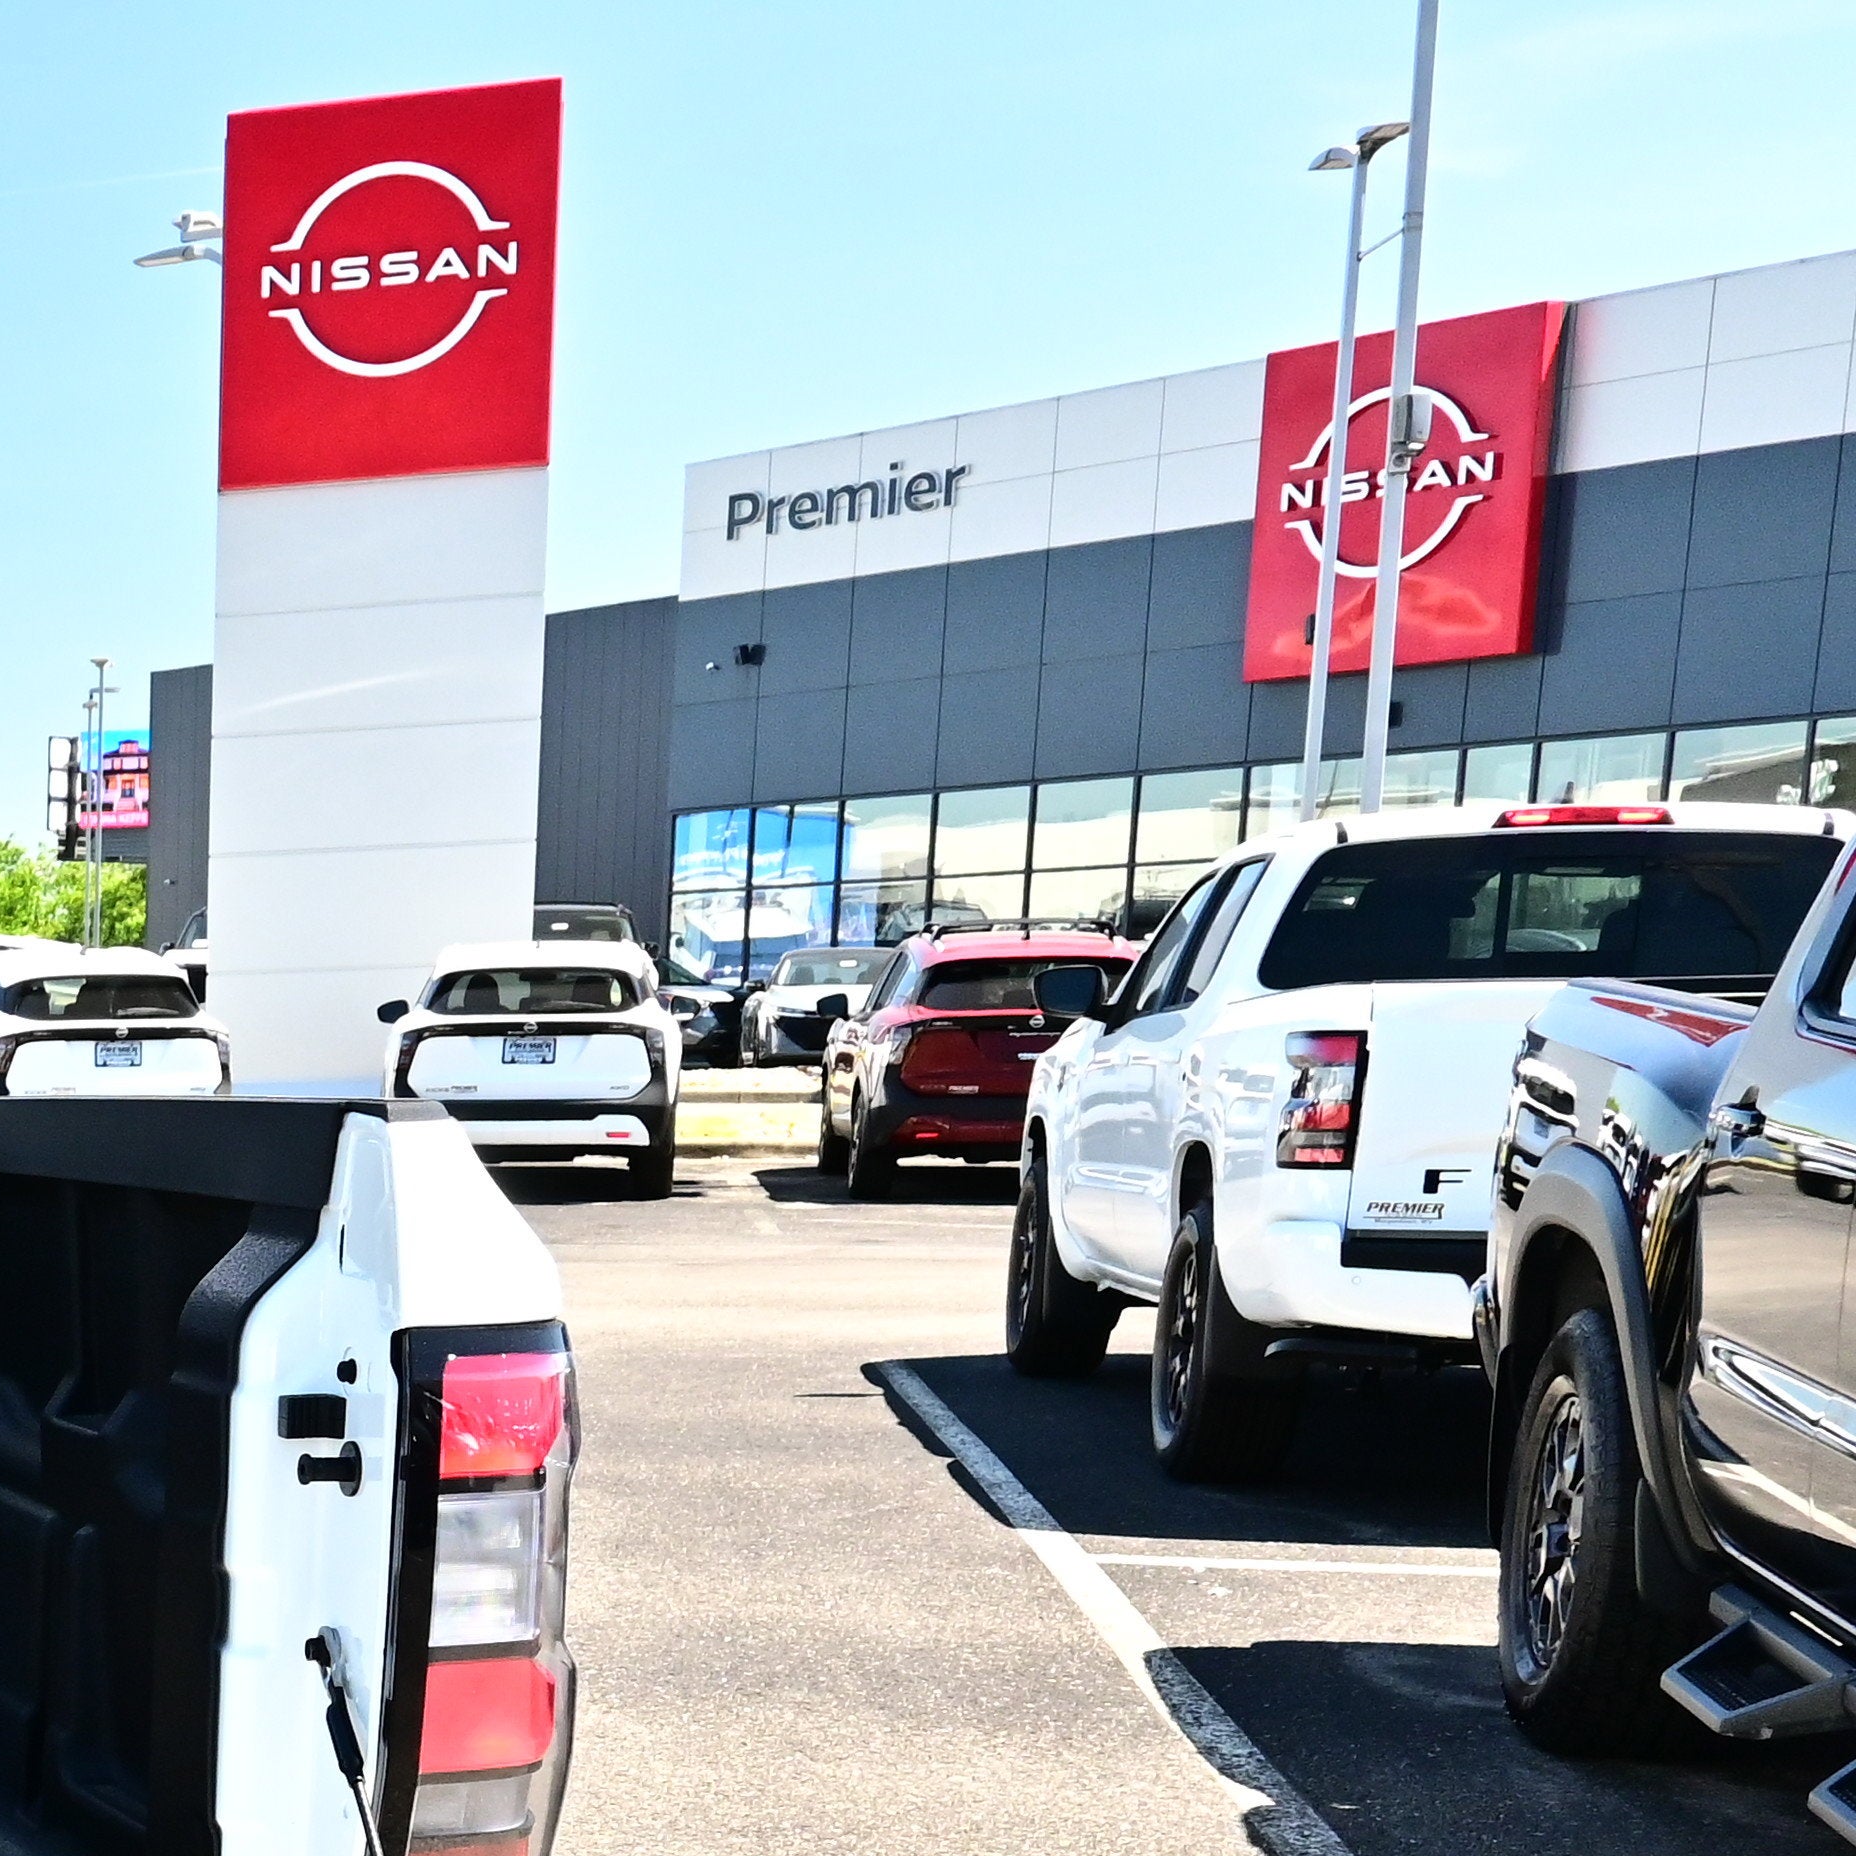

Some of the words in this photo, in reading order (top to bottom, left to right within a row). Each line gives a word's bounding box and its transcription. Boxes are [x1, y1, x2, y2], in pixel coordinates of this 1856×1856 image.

[261, 241, 518, 298] NISSAN
[726, 461, 970, 541] Premier
[1366, 1202, 1445, 1219] PREMIER
